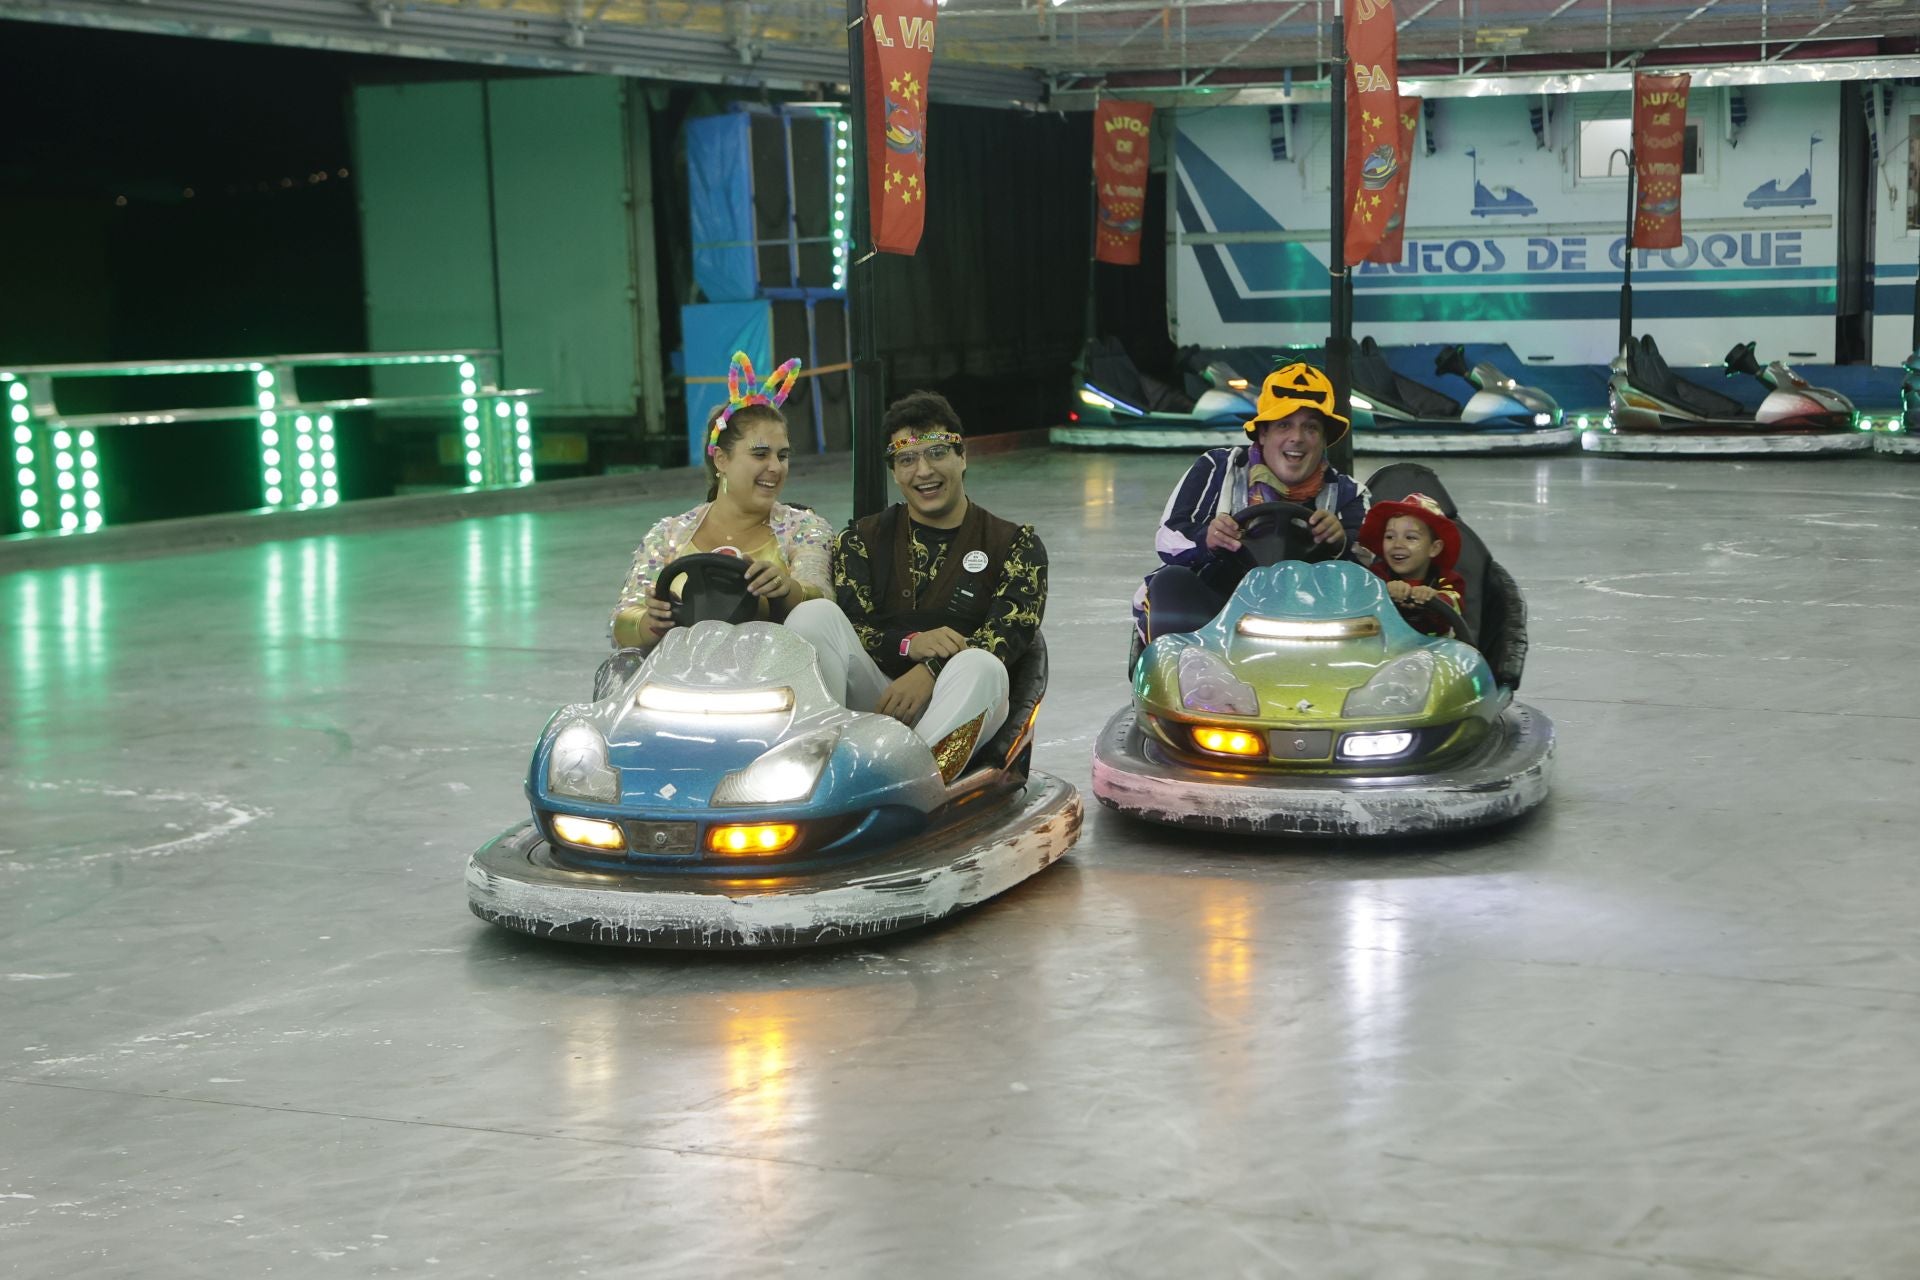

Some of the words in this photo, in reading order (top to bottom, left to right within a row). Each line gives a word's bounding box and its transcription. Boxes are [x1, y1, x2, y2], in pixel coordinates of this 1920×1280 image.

[1642, 91, 1686, 109] AUTOS
[1104, 116, 1150, 138] AUTOS
[1652, 112, 1671, 126] DE
[1116, 135, 1133, 153] DE
[1528, 237, 1587, 271] DE
